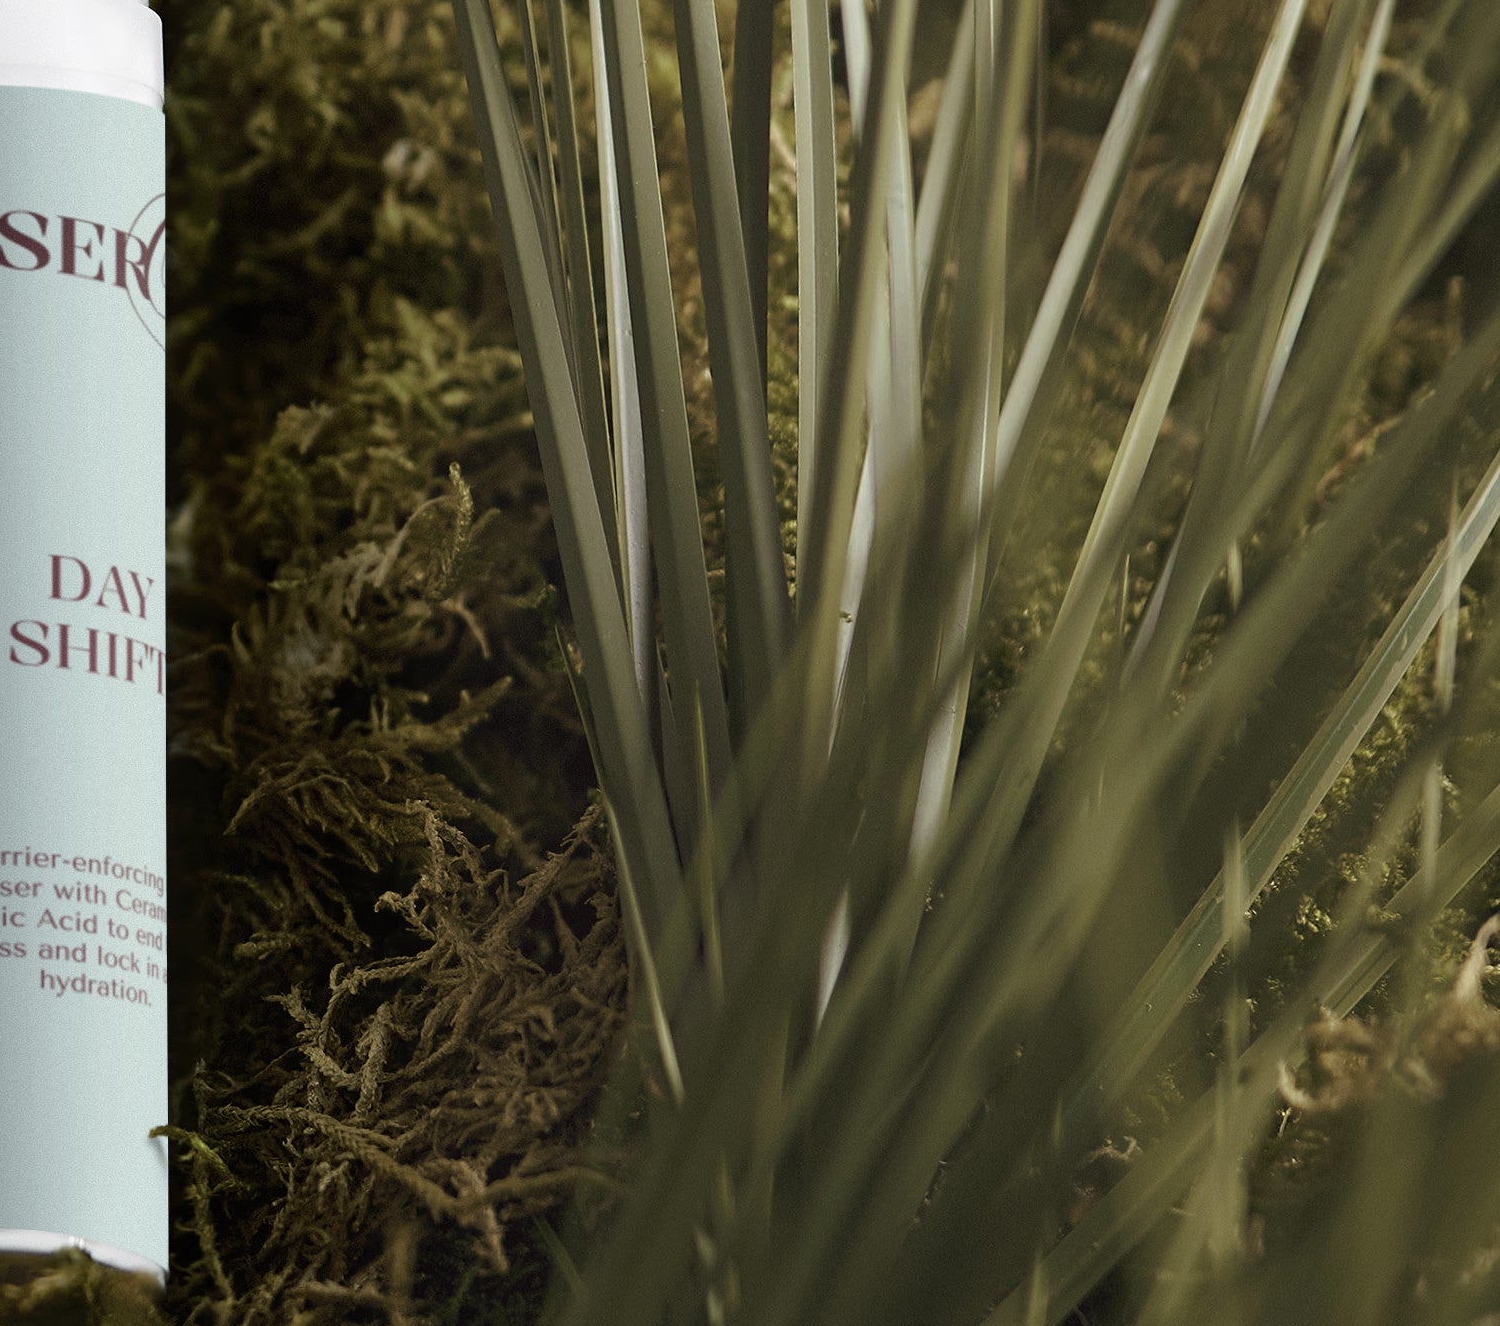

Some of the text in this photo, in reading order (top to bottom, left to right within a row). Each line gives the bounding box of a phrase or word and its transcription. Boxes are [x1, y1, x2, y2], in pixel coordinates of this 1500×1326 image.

[48, 554, 154, 619] DAY
[9, 619, 166, 696] SHIFT
[54, 881, 106, 906] with
[38, 909, 98, 934] Acid
[108, 918, 129, 940] to
[136, 929, 162, 951] end
[39, 943, 87, 963] and
[98, 945, 140, 974] lock
[147, 955, 159, 979] in
[40, 970, 152, 1006] hydration.
